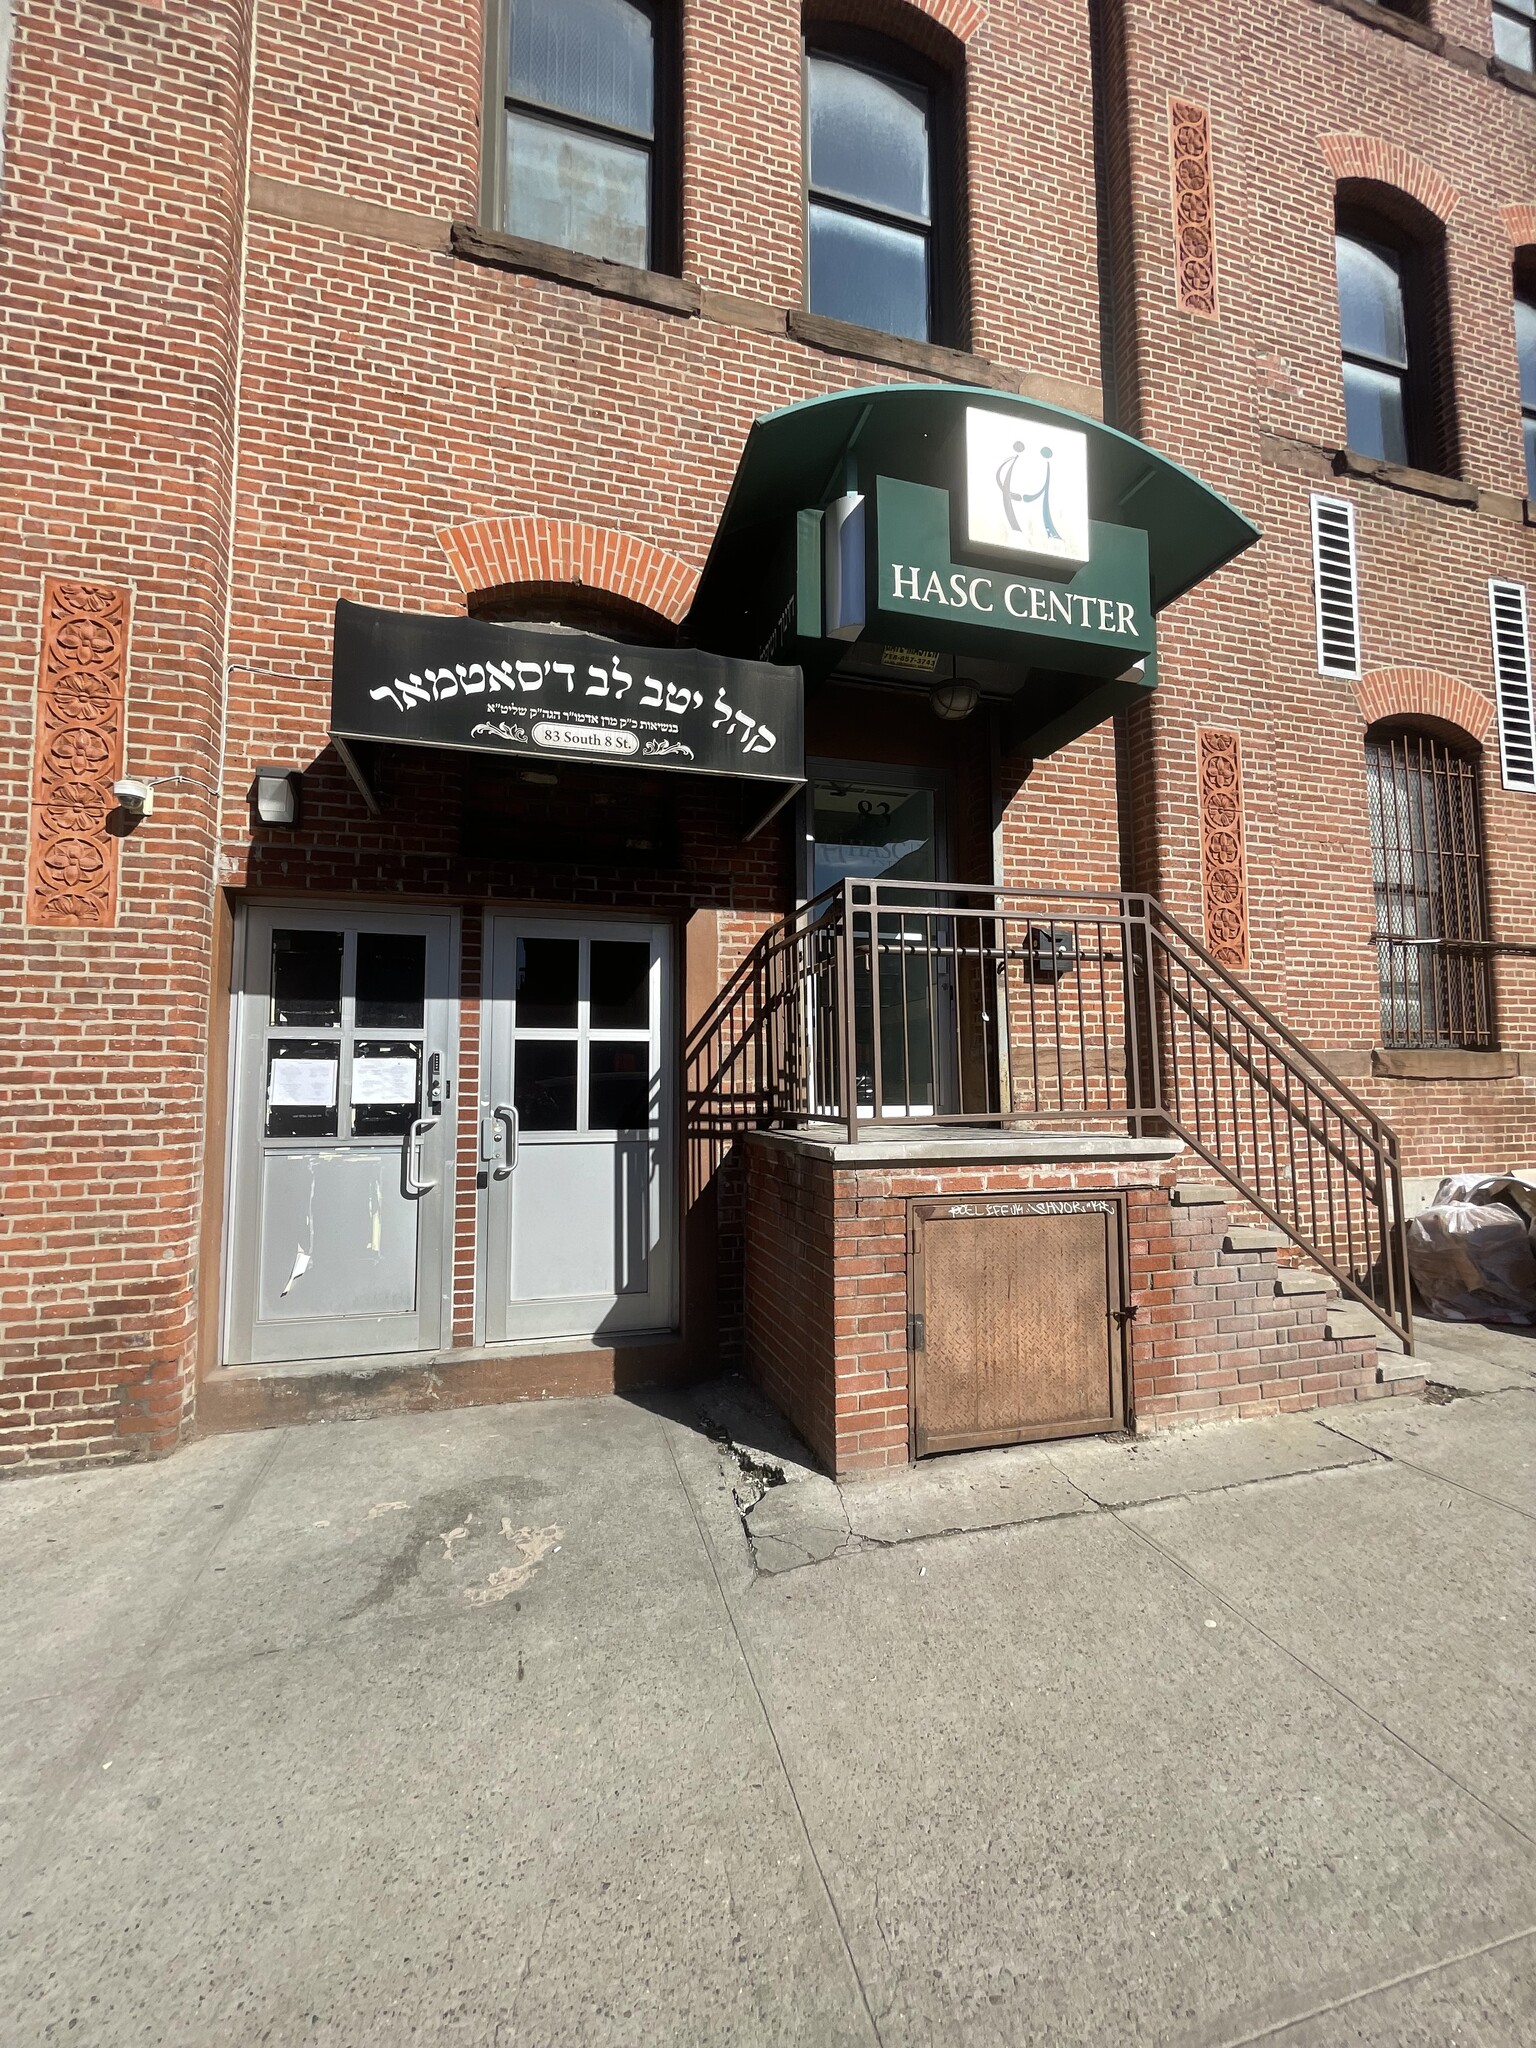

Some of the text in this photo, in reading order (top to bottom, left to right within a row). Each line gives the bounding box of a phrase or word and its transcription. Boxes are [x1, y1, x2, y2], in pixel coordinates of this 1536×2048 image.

[891, 563, 1140, 637] HASC CENTER
[585, 655, 633, 700] לב
[639, 675, 704, 714] יטב
[600, 716, 618, 727] מרן
[639, 720, 679, 734] בנשיאות
[711, 686, 777, 754] קהל
[544, 729, 632, 749] 83 South 8 St.
[857, 800, 891, 829] 83
